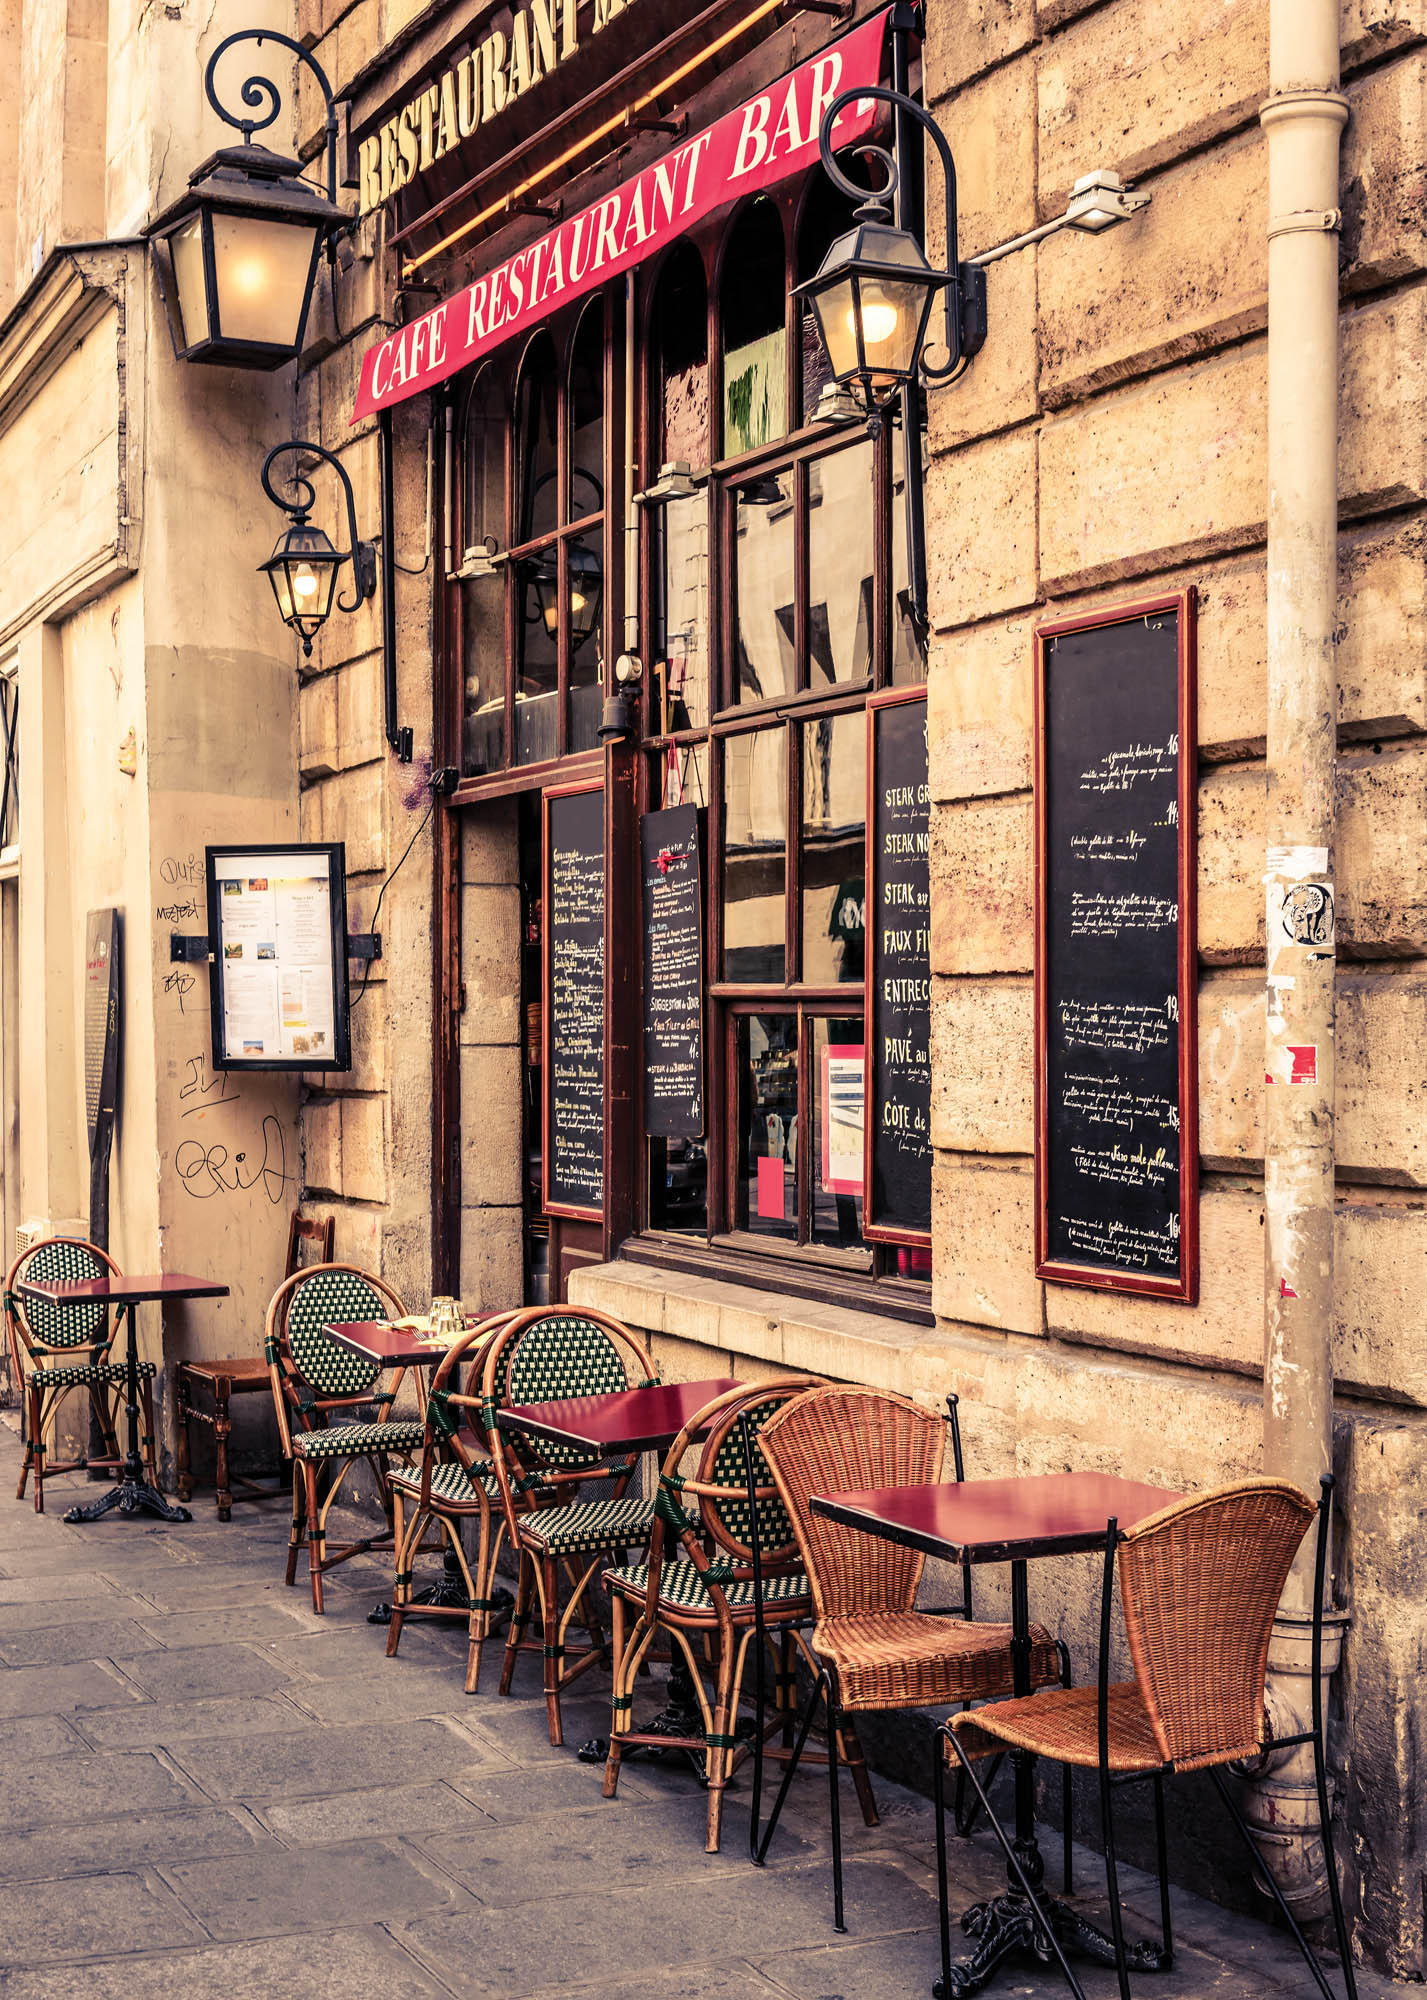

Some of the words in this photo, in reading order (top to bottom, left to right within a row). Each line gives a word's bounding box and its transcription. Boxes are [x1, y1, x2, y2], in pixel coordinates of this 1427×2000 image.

[358, 0, 580, 218] RESTAURANT
[371, 303, 448, 400] CAFE
[463, 130, 712, 349] RESTAURANT
[726, 51, 844, 182] BAR
[885, 785, 914, 808] STEAK
[885, 833, 915, 855] STEAK
[884, 882, 915, 905] STEAK
[883, 929, 912, 955] FAUX
[650, 996, 682, 1012] SUGGESTION
[884, 1027, 913, 1065] PAVÉ
[884, 1095, 910, 1129] CÔTE
[914, 1107, 926, 1130] de
